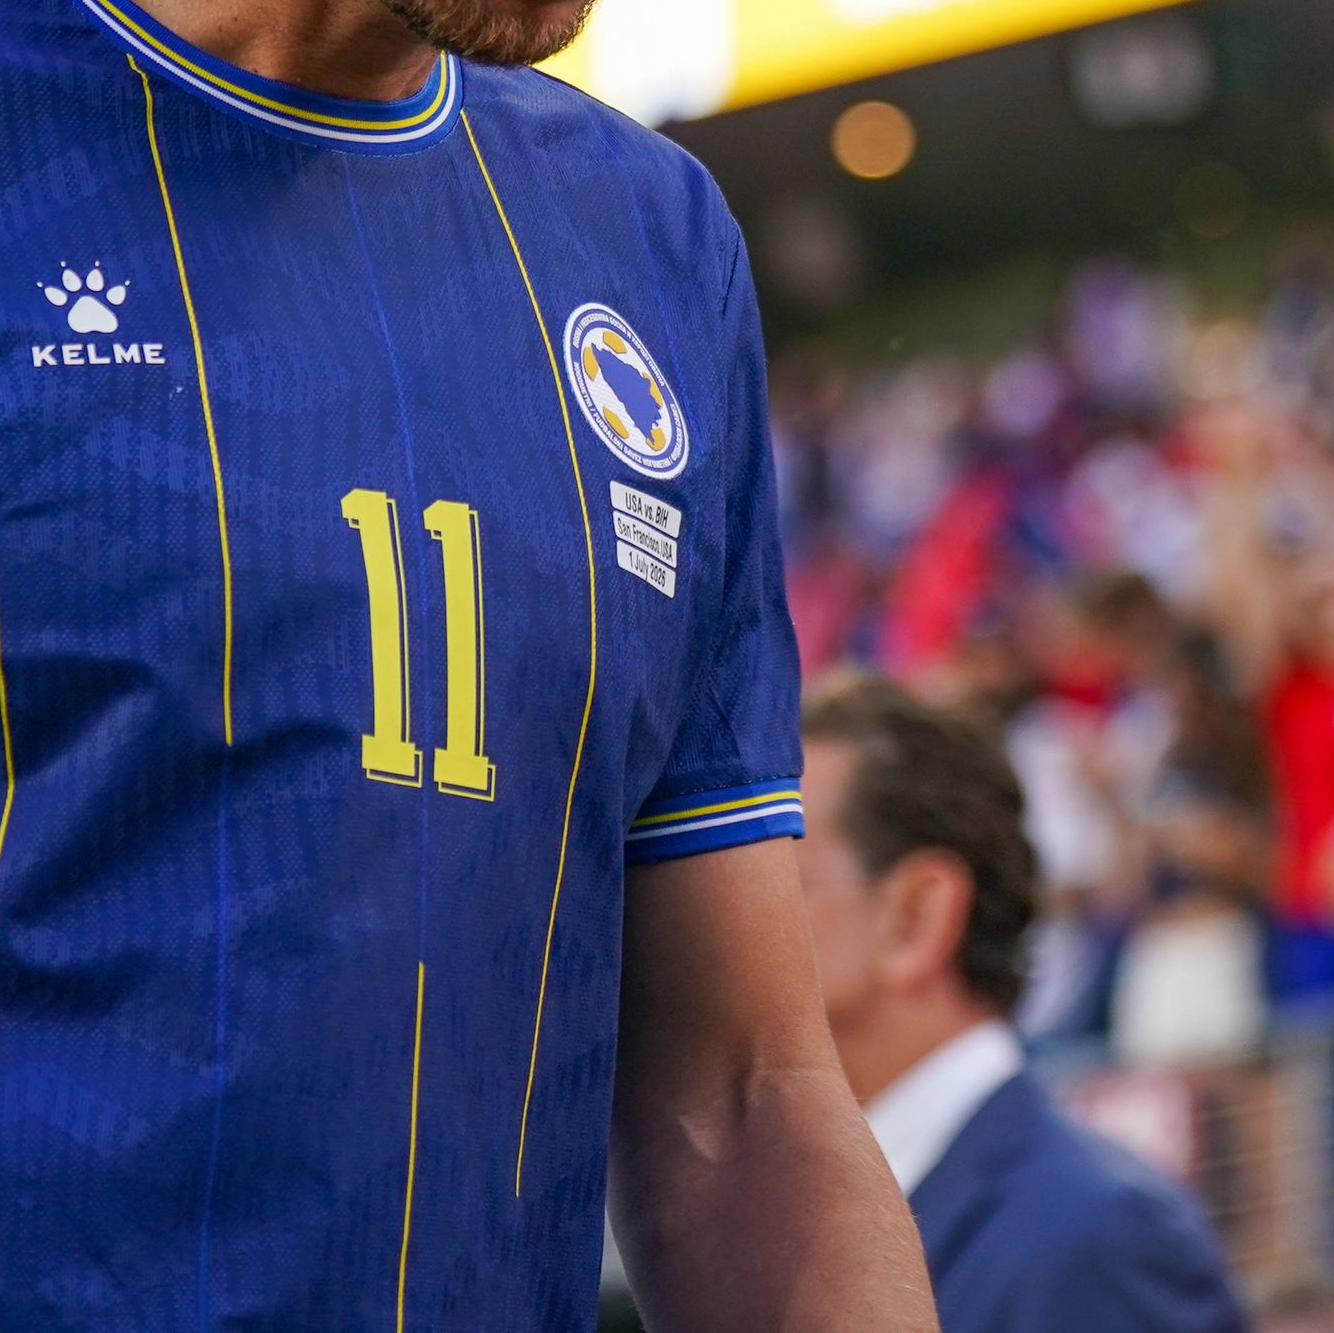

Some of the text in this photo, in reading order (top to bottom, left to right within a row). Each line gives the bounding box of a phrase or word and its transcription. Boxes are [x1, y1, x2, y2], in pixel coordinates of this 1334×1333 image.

[31, 343, 166, 367] KELME
[625, 492, 669, 529] USA vs. BIH
[617, 517, 632, 538] San
[660, 540, 673, 563] USA
[628, 551, 667, 589] 1 July 2026
[340, 488, 496, 802] 11
